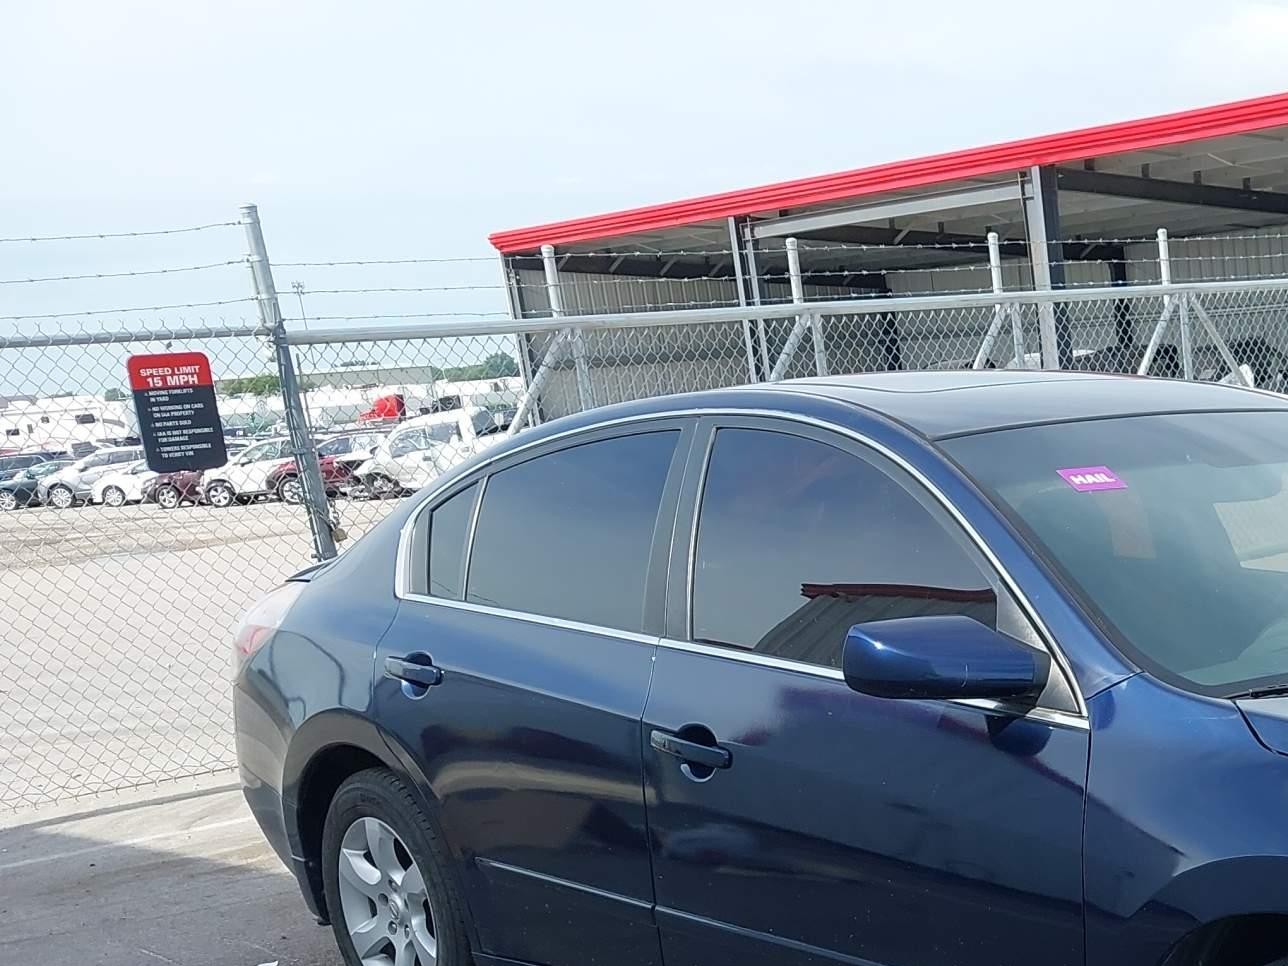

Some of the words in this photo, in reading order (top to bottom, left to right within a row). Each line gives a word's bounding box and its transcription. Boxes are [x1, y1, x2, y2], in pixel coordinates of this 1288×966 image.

[140, 368, 171, 376] SPEED
[174, 366, 200, 374] LIMIT
[147, 377, 162, 387] 15
[167, 375, 198, 385] MPH
[1069, 473, 1116, 484] HAIL
